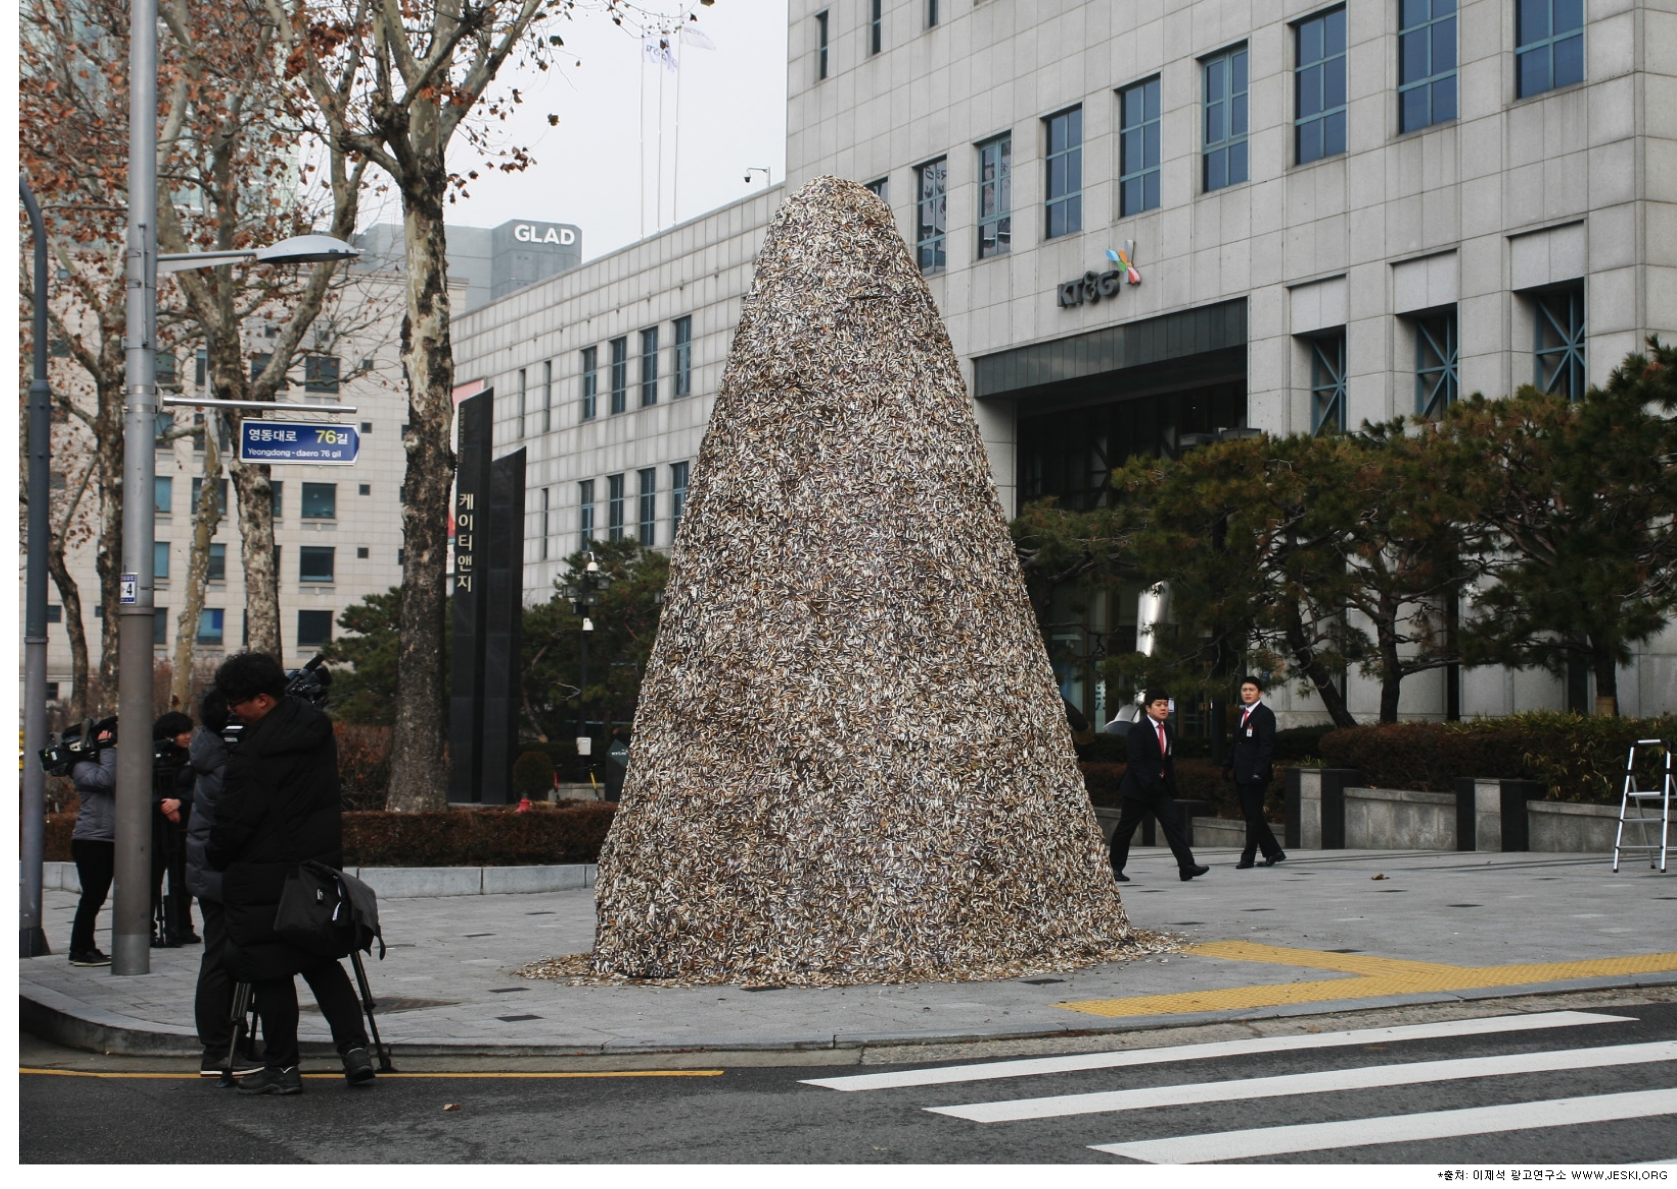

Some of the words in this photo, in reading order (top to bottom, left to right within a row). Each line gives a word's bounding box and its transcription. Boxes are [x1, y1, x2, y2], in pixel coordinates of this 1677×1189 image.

[514, 224, 575, 246] GLAD
[1057, 270, 1121, 307] KT&G
[248, 428, 298, 442] 영동대로
[315, 430, 348, 445] 76길
[321, 449, 331, 458] 76
[332, 450, 342, 459] gil
[457, 493, 474, 592] 케이티앤지
